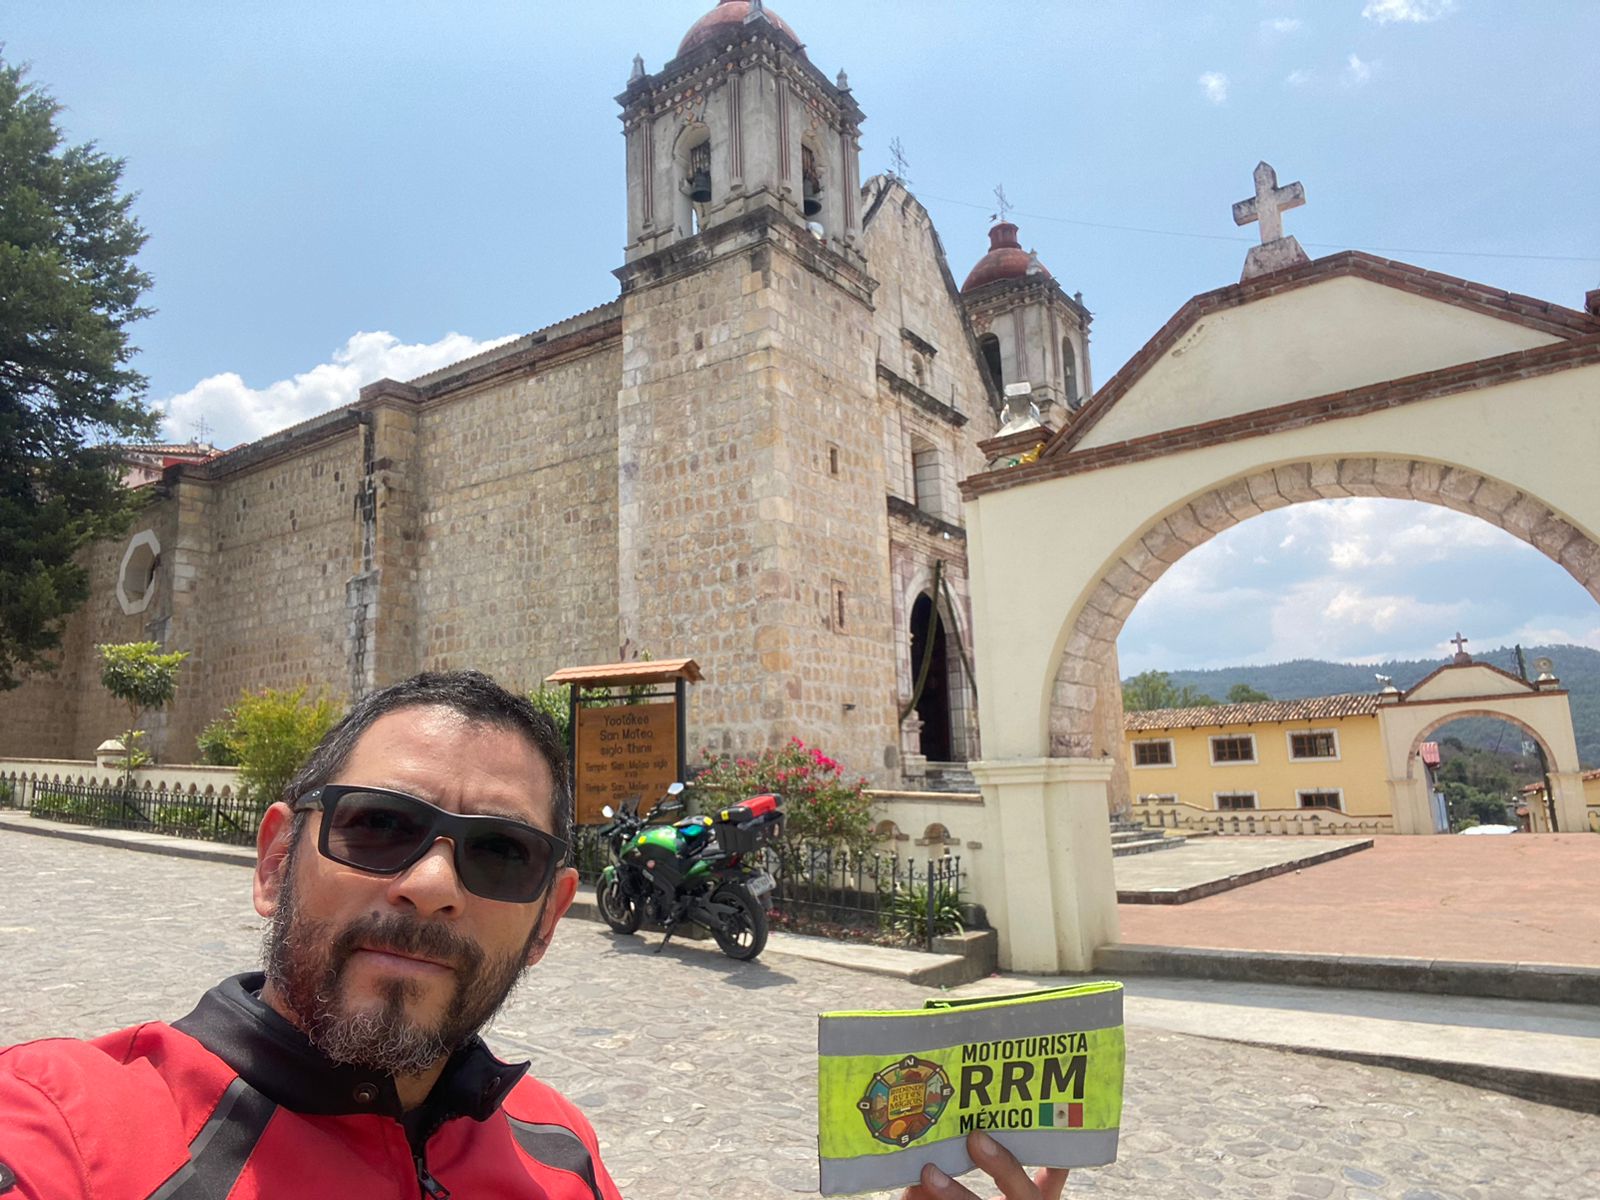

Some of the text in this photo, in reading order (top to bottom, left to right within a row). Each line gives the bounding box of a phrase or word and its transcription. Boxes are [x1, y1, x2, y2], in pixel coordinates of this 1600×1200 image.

[600, 728, 654, 742] San Mateo
[962, 1033, 1088, 1063] MOTOTURISTA
[904, 1058, 915, 1066] N
[959, 1055, 1088, 1109] RRM
[942, 1087, 951, 1096] E
[960, 1107, 1033, 1134] MÉXICO
[901, 1134, 909, 1144] S
